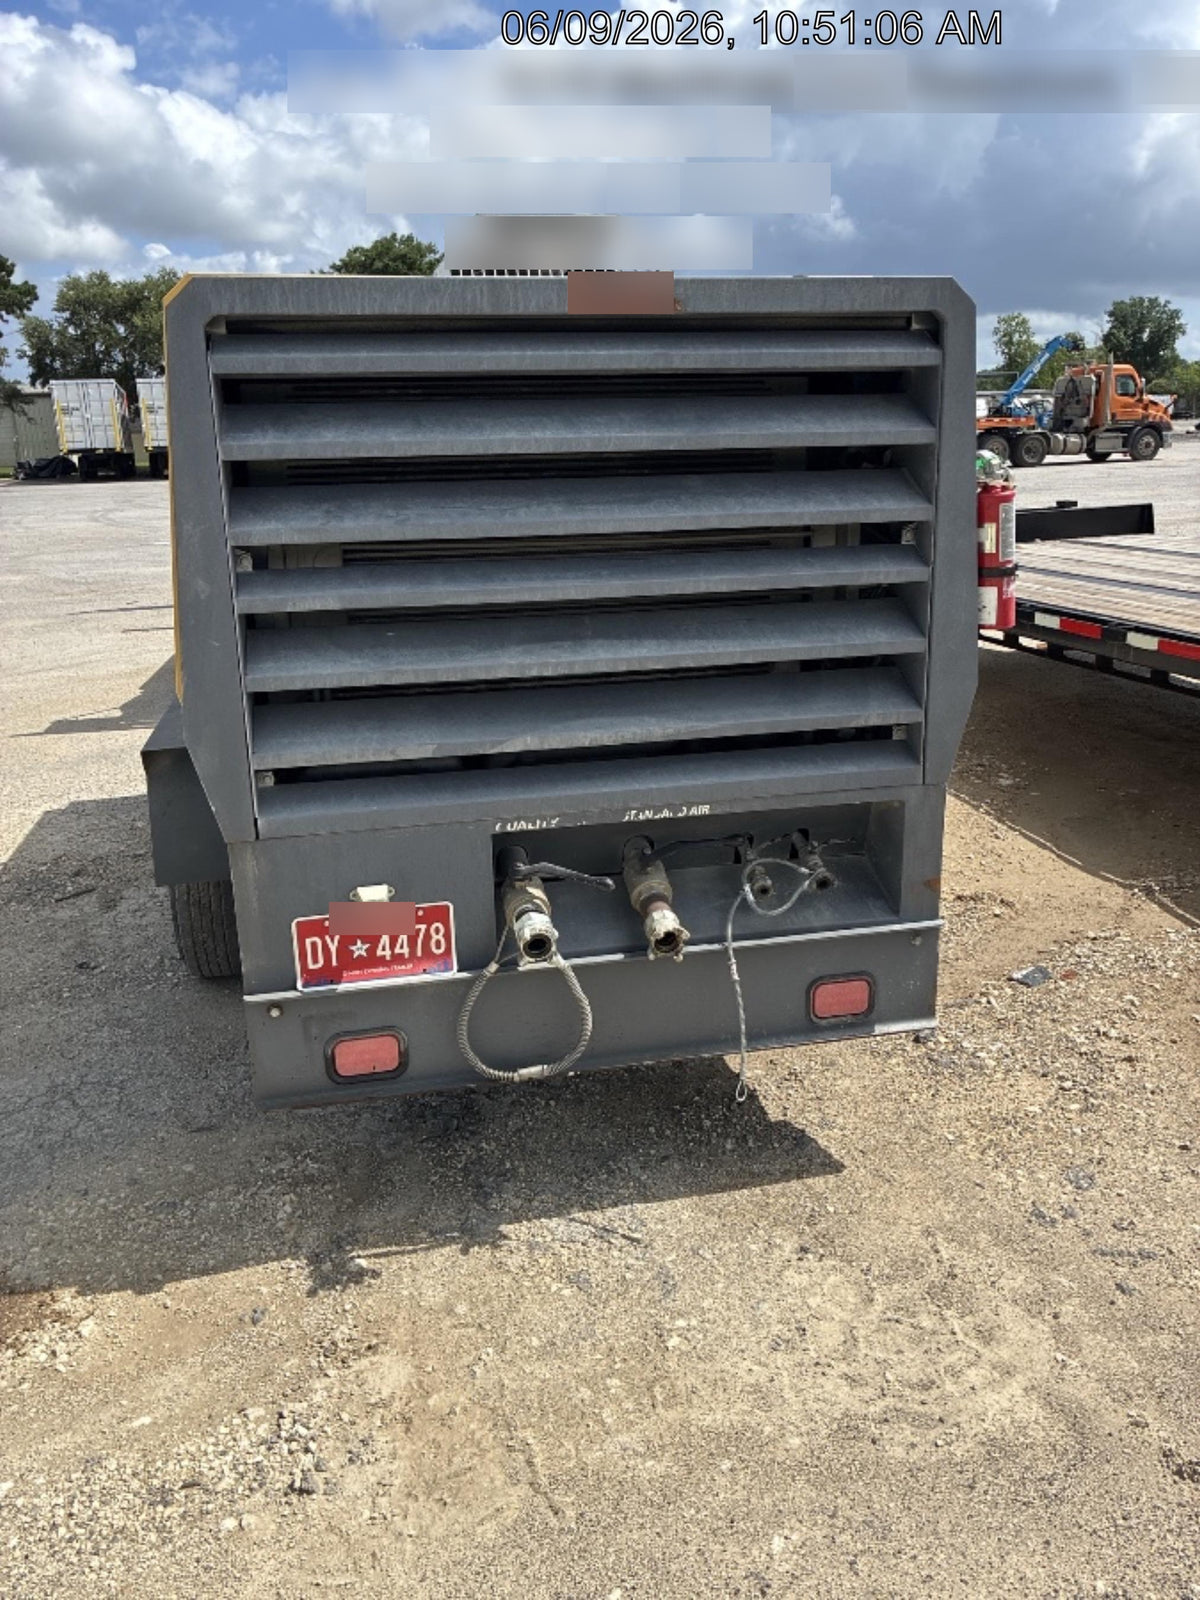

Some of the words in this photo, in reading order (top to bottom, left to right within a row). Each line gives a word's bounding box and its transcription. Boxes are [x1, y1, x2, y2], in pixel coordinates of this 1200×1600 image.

[688, 804, 710, 817] AIR
[305, 934, 340, 970] DY
[376, 922, 446, 961] 4478
